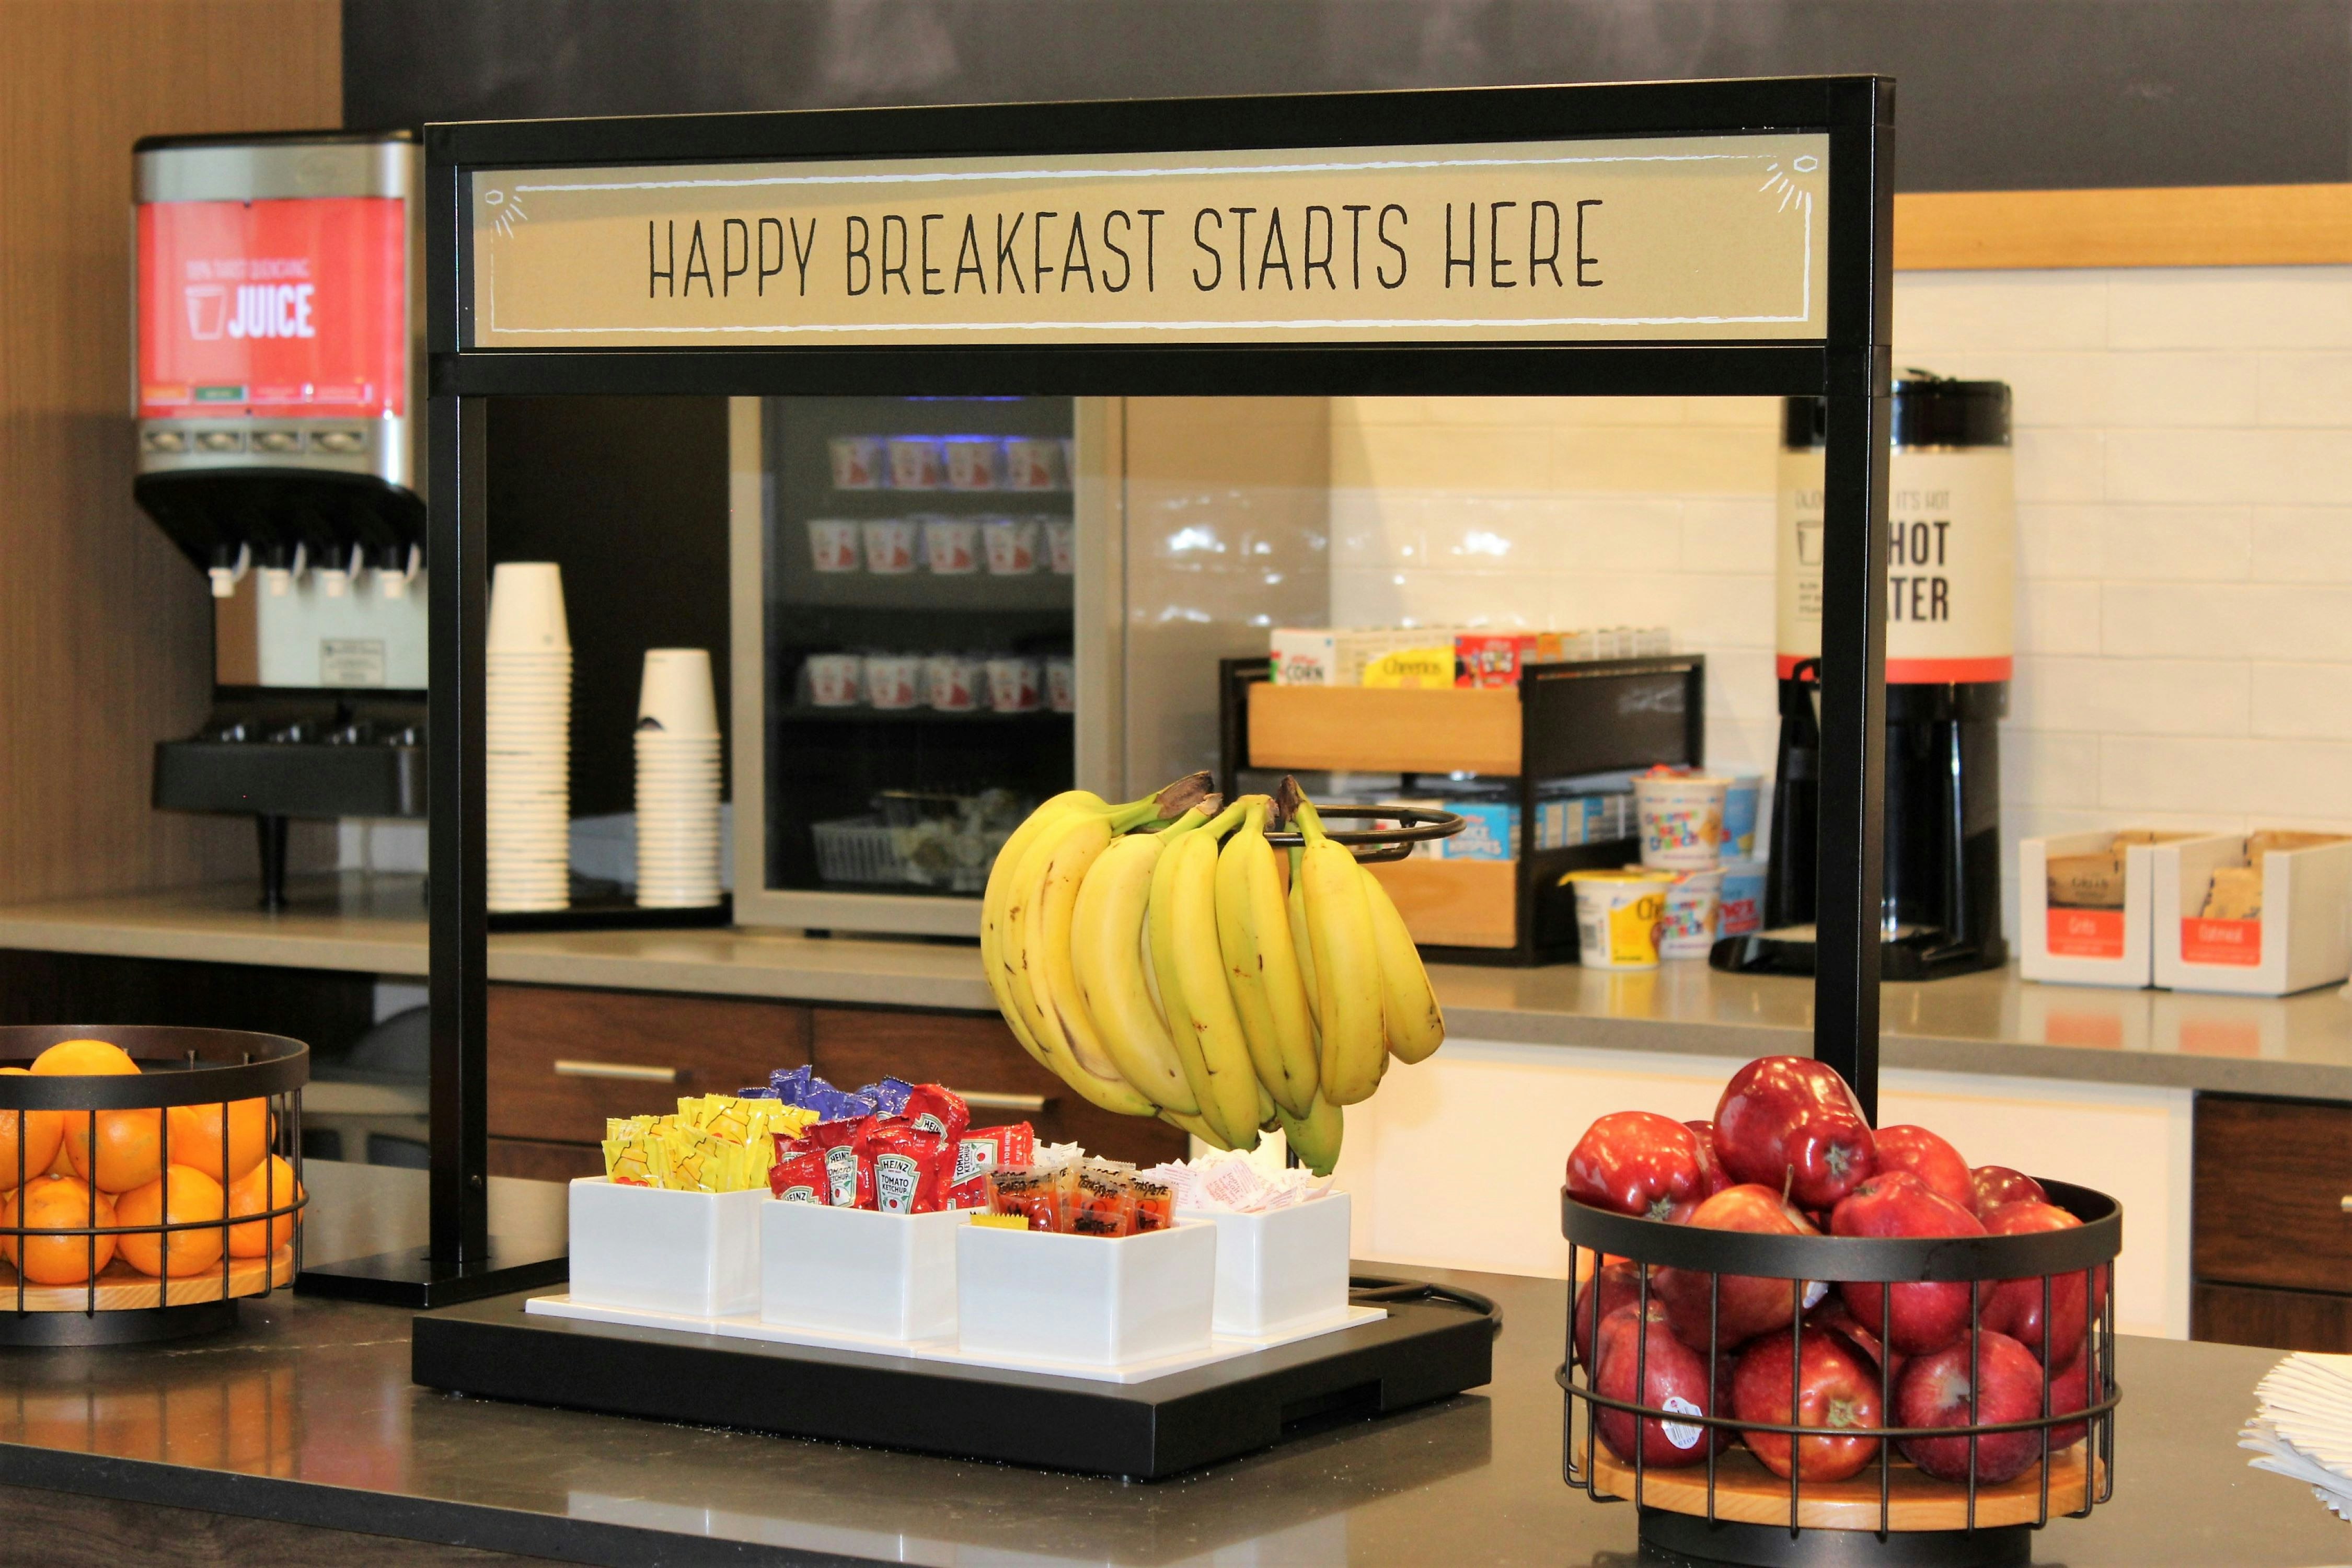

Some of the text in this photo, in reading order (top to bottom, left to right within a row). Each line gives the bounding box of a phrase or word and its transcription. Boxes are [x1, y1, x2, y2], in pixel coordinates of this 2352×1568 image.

[649, 200, 1604, 297] HAPPY BREAKFAST STARTS HERE
[228, 283, 316, 338] JUICE
[1887, 522, 1951, 567] HOT
[1886, 577, 1950, 622] TER
[1286, 665, 1324, 682] CORN
[1382, 658, 1442, 676] Cheerios
[924, 1120, 941, 1132] HEI
[830, 1151, 849, 1163] HEIN
[883, 1160, 909, 1172] HEINZ
[881, 1174, 909, 1187] TOMATO
[882, 1183, 907, 1194] KETCHUP
